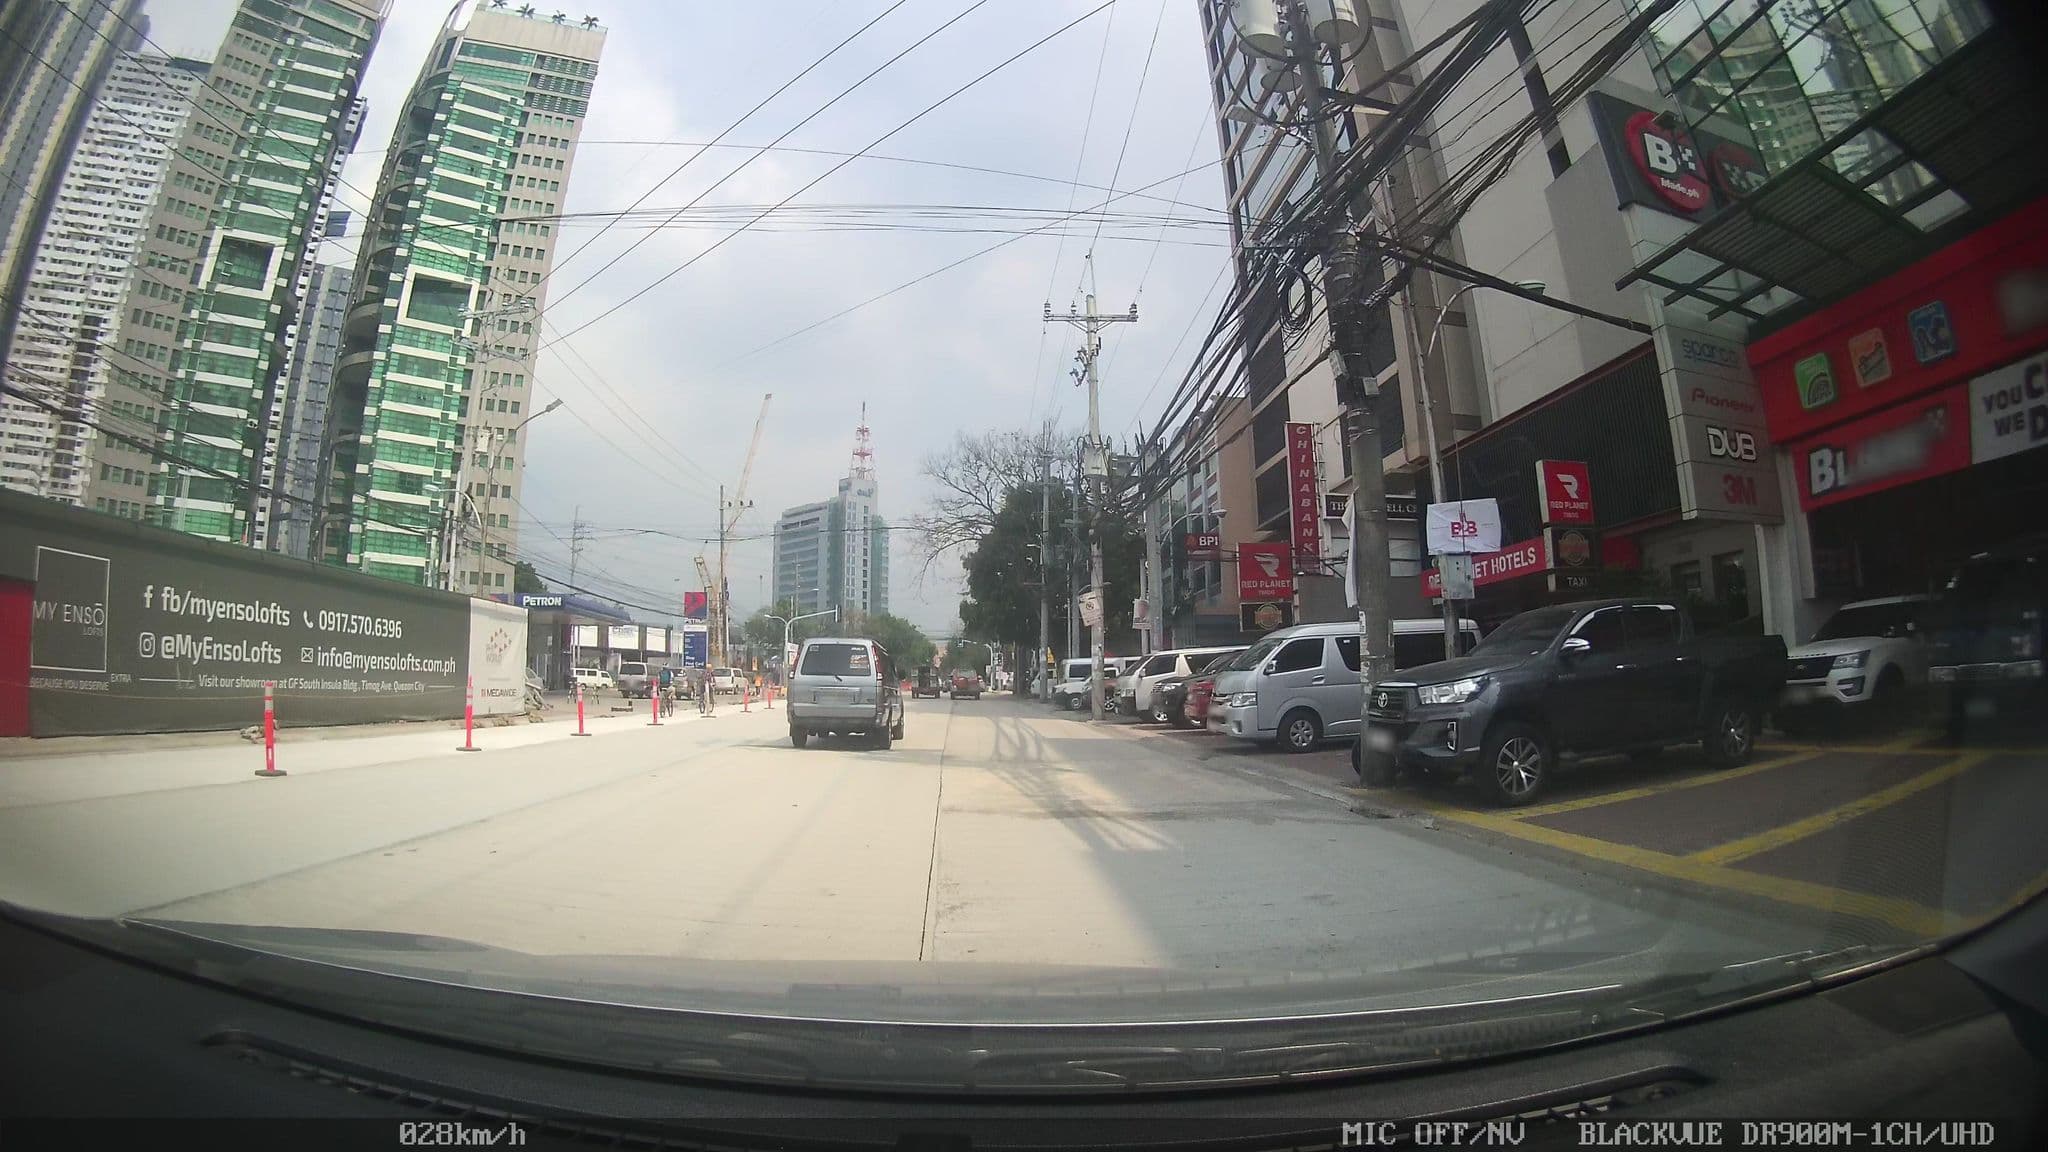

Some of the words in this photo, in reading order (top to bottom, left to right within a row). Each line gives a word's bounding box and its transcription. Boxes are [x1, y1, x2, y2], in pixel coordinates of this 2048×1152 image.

[1691, 387, 1755, 413] Pioneer
[1983, 385, 2022, 413] YOU
[1995, 411, 2025, 437] WE
[1707, 426, 1757, 461] DUB
[1296, 425, 1314, 552] CHINABANK
[1723, 474, 1757, 506] 3M
[1565, 501, 1589, 510] PLANET
[1199, 536, 1219, 546] BPI
[1491, 547, 1536, 575] HOTELS
[1241, 580, 1258, 589] RED
[1260, 580, 1291, 588] PLANET
[1567, 576, 1588, 587] TAXI
[32, 600, 58, 621] MY
[161, 586, 291, 626] fb/myensolofts
[523, 596, 562, 606] PETRON
[318, 610, 402, 639] 0917.570.6396
[161, 634, 282, 665] @MyEnsoLofts
[317, 646, 456, 676] info@myensolofts.com.ph
[198, 674, 218, 687] Visit
[220, 678, 235, 688] our
[279, 679, 287, 689] at
[288, 677, 298, 689] GF
[299, 677, 320, 690] South
